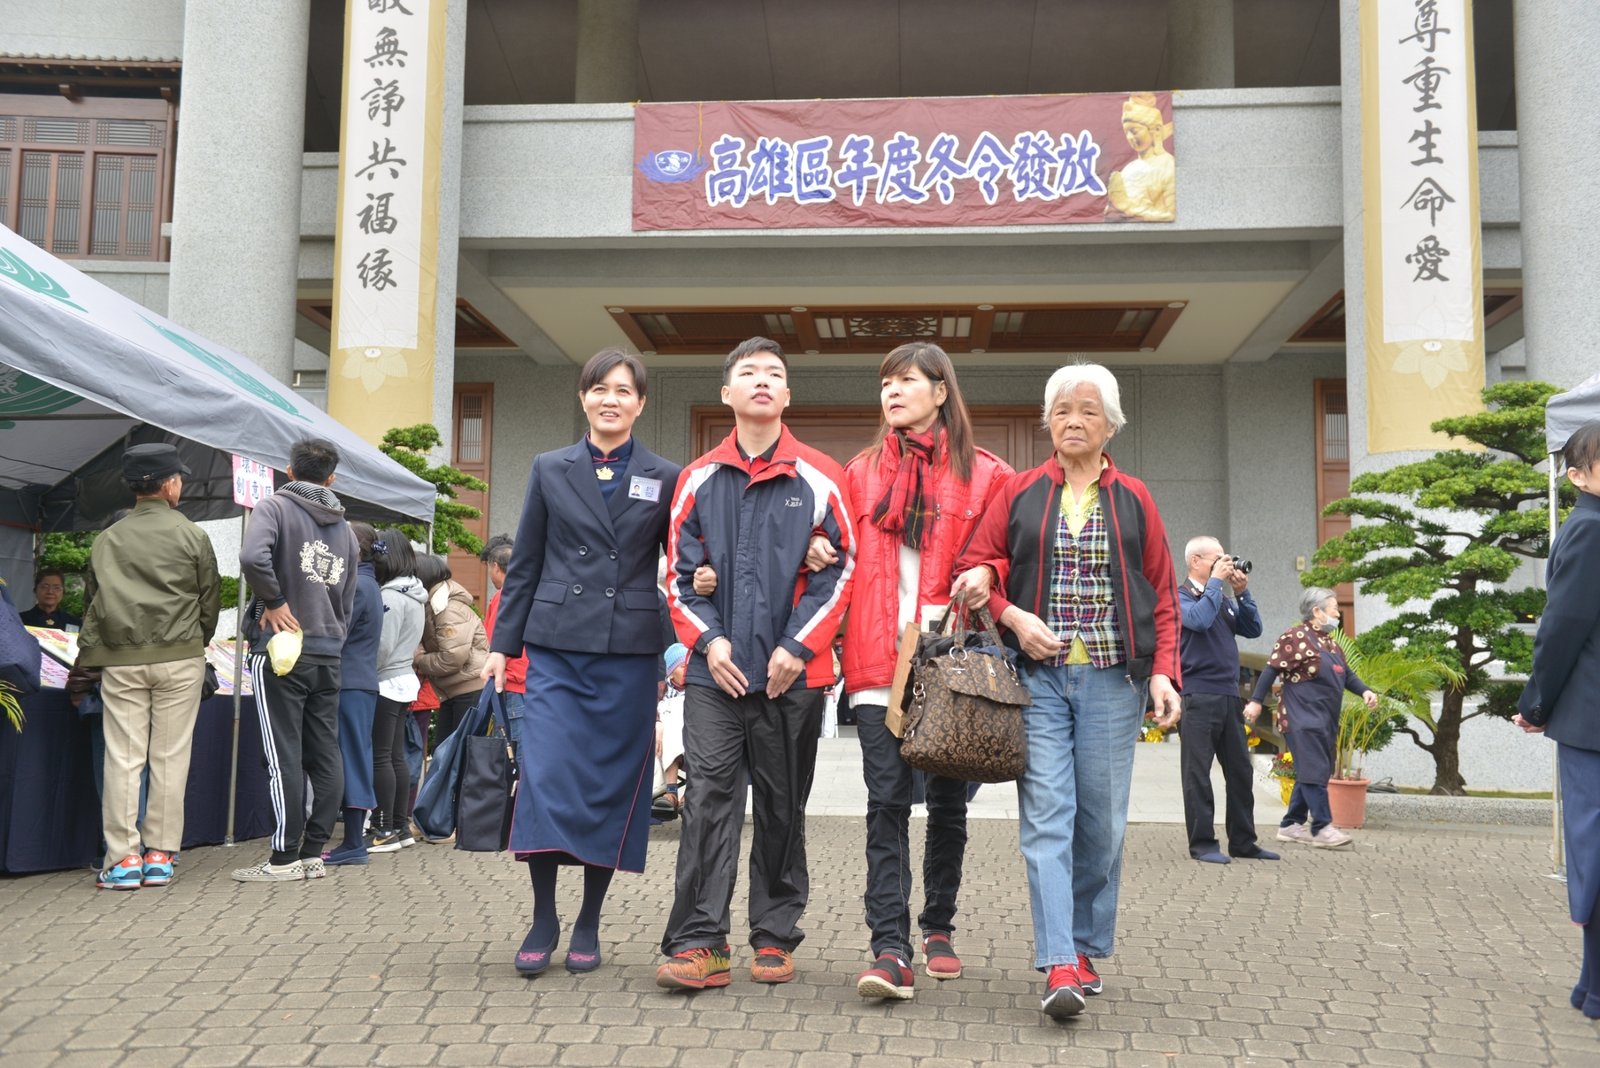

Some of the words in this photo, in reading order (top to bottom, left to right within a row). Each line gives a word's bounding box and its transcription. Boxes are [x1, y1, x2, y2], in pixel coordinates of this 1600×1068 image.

[705, 130, 1107, 208] 高雄區年度冬令發放
[1399, 0, 1456, 282] 尊重生命愛
